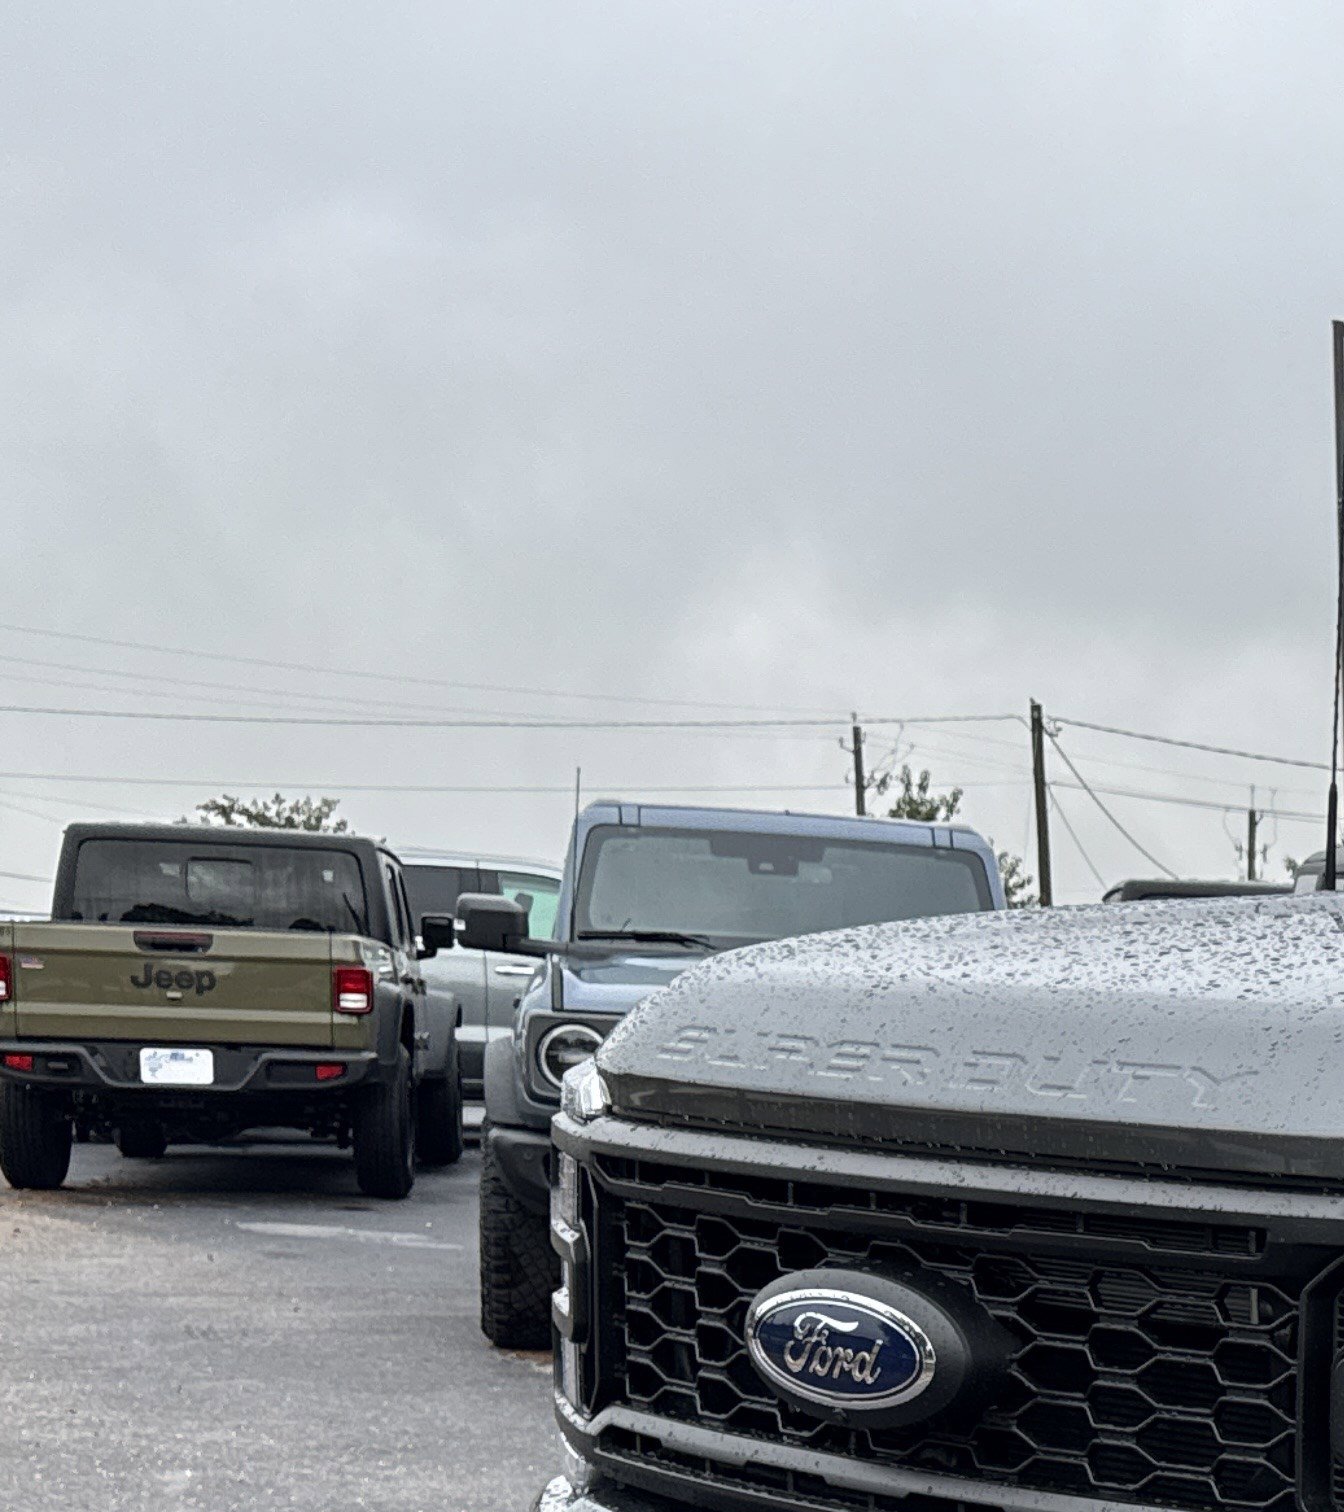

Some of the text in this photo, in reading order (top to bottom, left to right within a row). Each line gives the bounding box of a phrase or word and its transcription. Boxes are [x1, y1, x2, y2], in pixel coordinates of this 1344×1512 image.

[130, 961, 217, 996] Jeep
[656, 1023, 1260, 1110] SUPER DUTY
[784, 1311, 884, 1385] Ford
